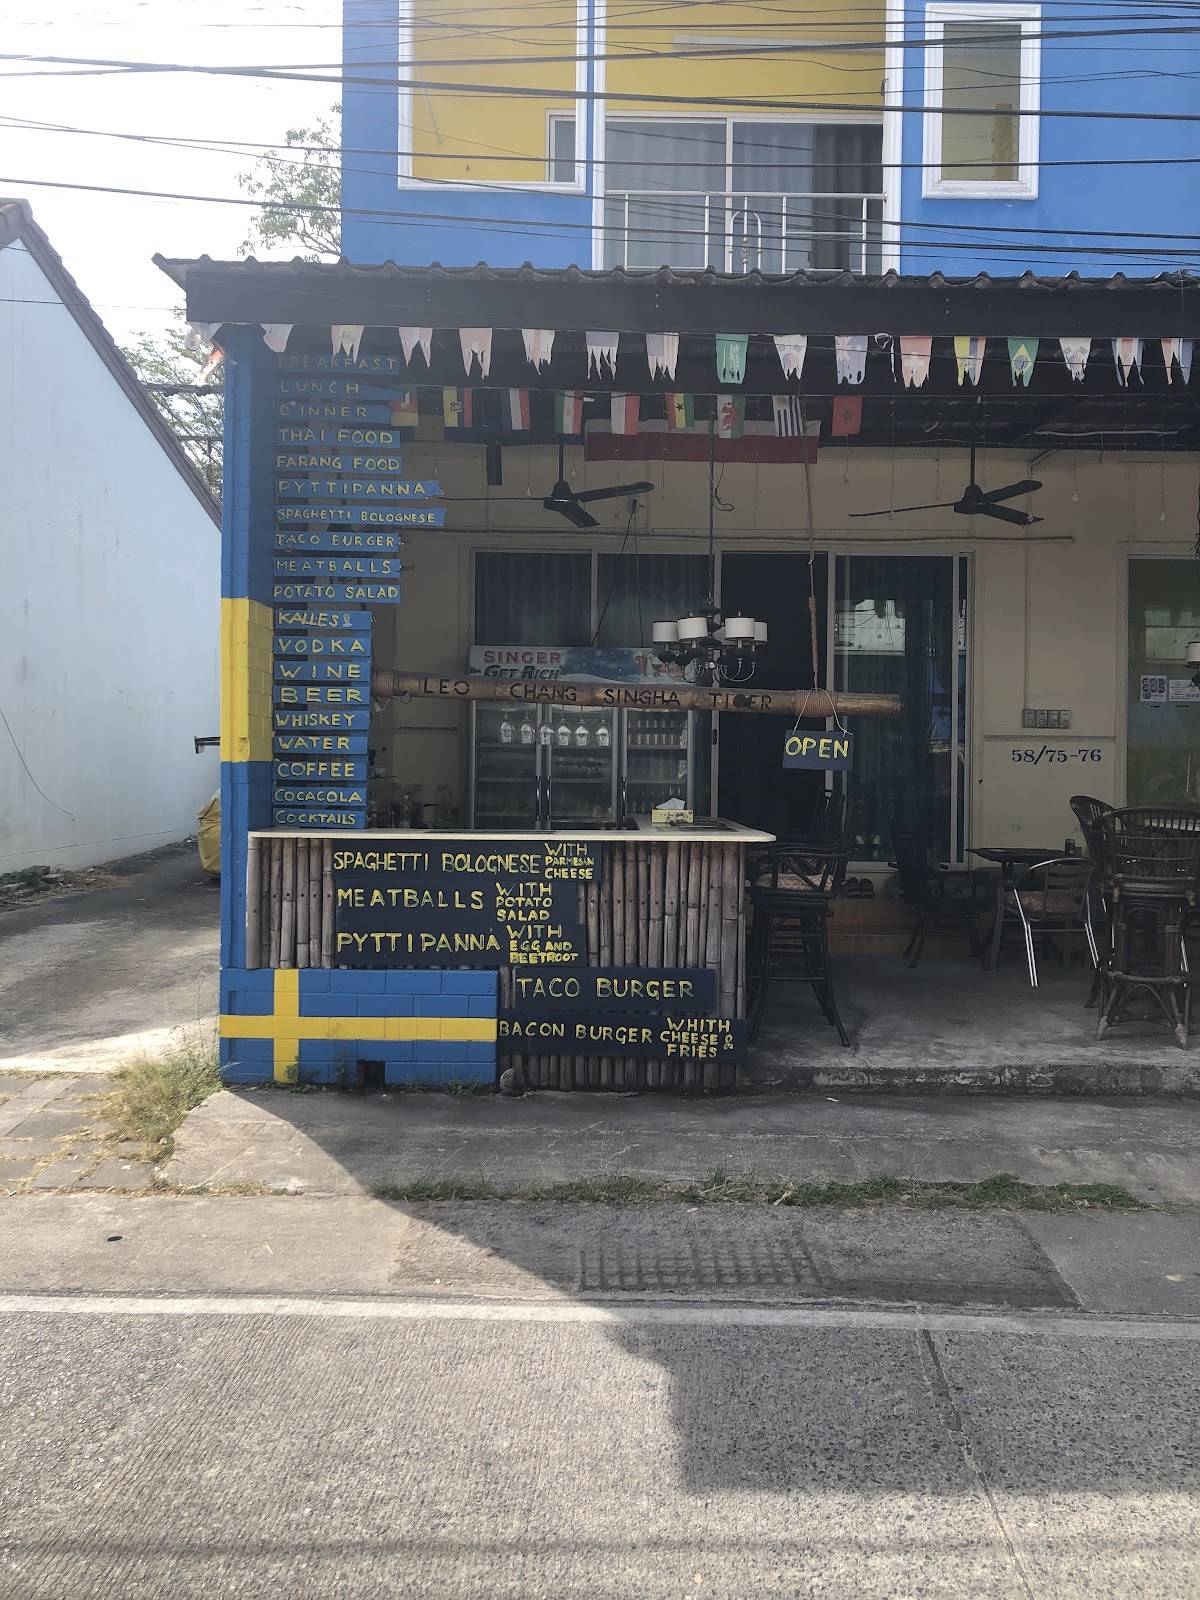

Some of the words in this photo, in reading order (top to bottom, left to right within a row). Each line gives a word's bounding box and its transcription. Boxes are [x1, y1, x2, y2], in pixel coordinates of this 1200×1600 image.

[280, 381, 360, 394] LUNCH
[280, 403, 368, 417] DINNER
[279, 428, 325, 442] THAI
[337, 429, 393, 443] FOOD
[276, 455, 342, 470] FARANG
[353, 458, 400, 471] FOOD
[278, 480, 426, 495] PYTTIPANNA
[277, 509, 351, 521] SPAGHETTI
[360, 511, 435, 524] BOLOGNESE
[275, 533, 320, 545] TACO
[332, 534, 394, 547] BURGER
[276, 559, 391, 574] MEATBALLS
[273, 585, 336, 598] POTATO
[345, 585, 399, 598] SALAD
[278, 611, 338, 628] KALLES
[278, 638, 366, 653] VODKA
[484, 650, 561, 664] SINGER
[280, 663, 361, 679] WINE
[280, 688, 363, 703] BEER
[423, 678, 470, 695] LEO
[510, 683, 577, 701] CHANG
[603, 688, 681, 706] SINGHA
[275, 712, 356, 727] WHISKEY
[278, 736, 350, 751] WATER
[785, 736, 849, 759] OPEN
[1012, 745, 1102, 765] 58/75-76
[277, 762, 355, 778] COFFEE
[274, 788, 363, 803] COCACOLA
[275, 811, 356, 825] COCKTAILS
[544, 842, 588, 856] WITH
[333, 851, 429, 872] SPAGHETTI
[441, 853, 541, 874] BOLOGNESE
[544, 867, 593, 880] CHEESE
[495, 881, 552, 897] WITH
[337, 888, 484, 910] MEATBALLS
[496, 896, 552, 908] POTATO
[496, 908, 550, 921] SALAD
[506, 924, 562, 939] WITH
[510, 940, 541, 952] EGG
[545, 940, 573, 952] AND
[510, 951, 579, 964] BEETROOT
[516, 977, 580, 998] TACO
[596, 977, 695, 1000] BURGER
[499, 1020, 565, 1037] BACON
[576, 1024, 653, 1045] BURGER
[667, 1017, 731, 1033] WHITH
[659, 1030, 718, 1047] CHEESE
[723, 1035, 735, 1050] &
[667, 1044, 718, 1059] FRIES
